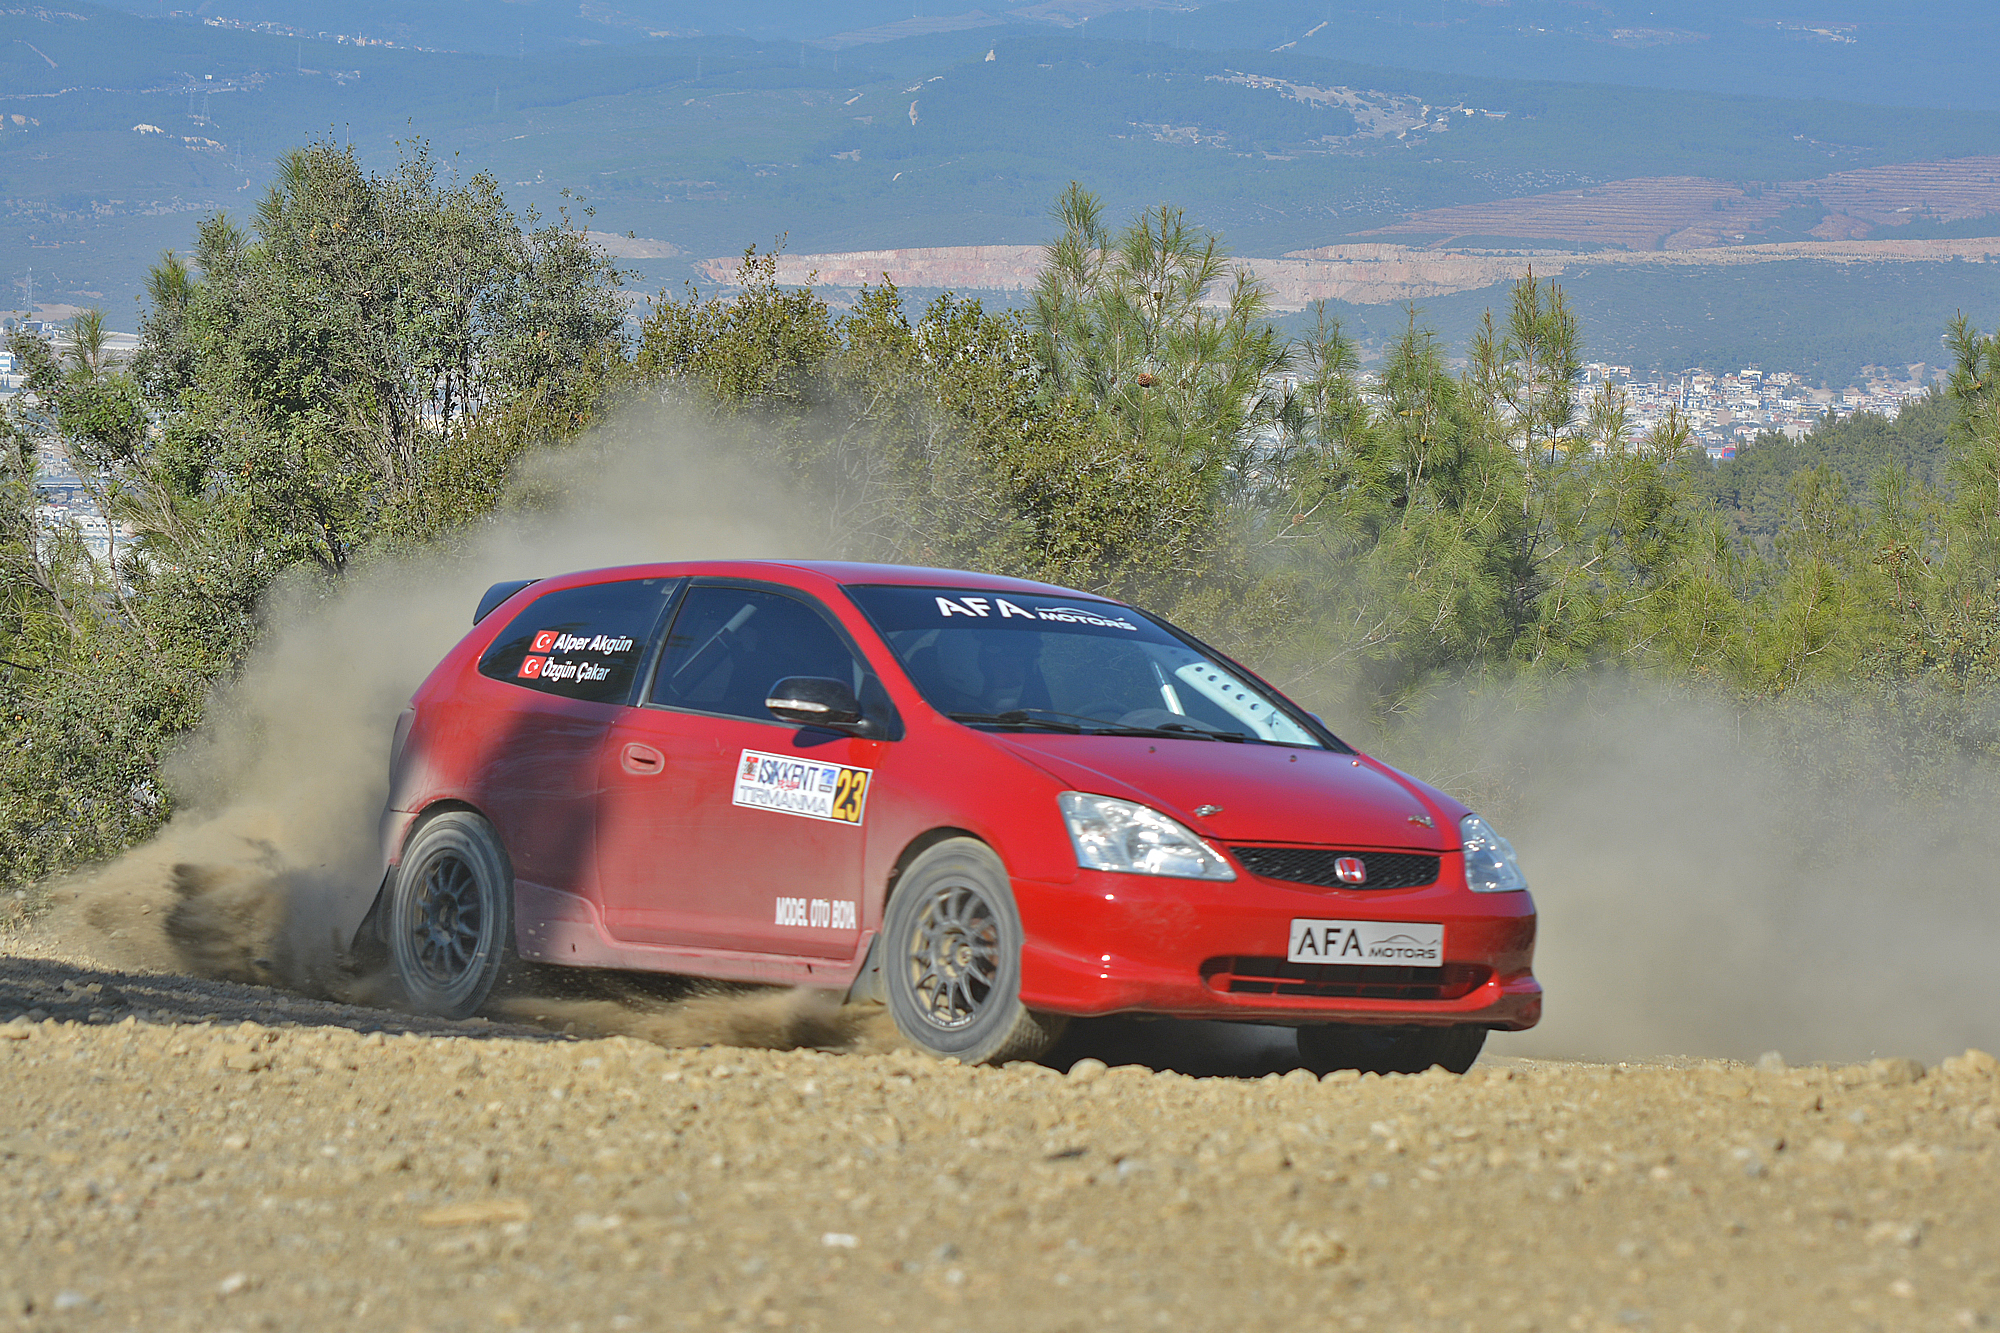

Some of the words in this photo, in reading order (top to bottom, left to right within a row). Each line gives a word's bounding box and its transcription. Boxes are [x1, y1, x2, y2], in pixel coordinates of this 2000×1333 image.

[934, 596, 1037, 620] AFA
[1037, 611, 1138, 631] MOTORS
[553, 633, 591, 655] Alper
[588, 634, 633, 655] Akgün
[541, 656, 577, 682] Özgün
[576, 661, 611, 684] Çakar
[740, 785, 829, 814] TIRMANMA
[832, 769, 867, 822] 23
[774, 896, 808, 927] MODEL
[810, 898, 831, 928] OTO
[831, 899, 857, 929] BOYA
[1296, 927, 1363, 957] AFA
[1368, 947, 1436, 959] MOTORS
